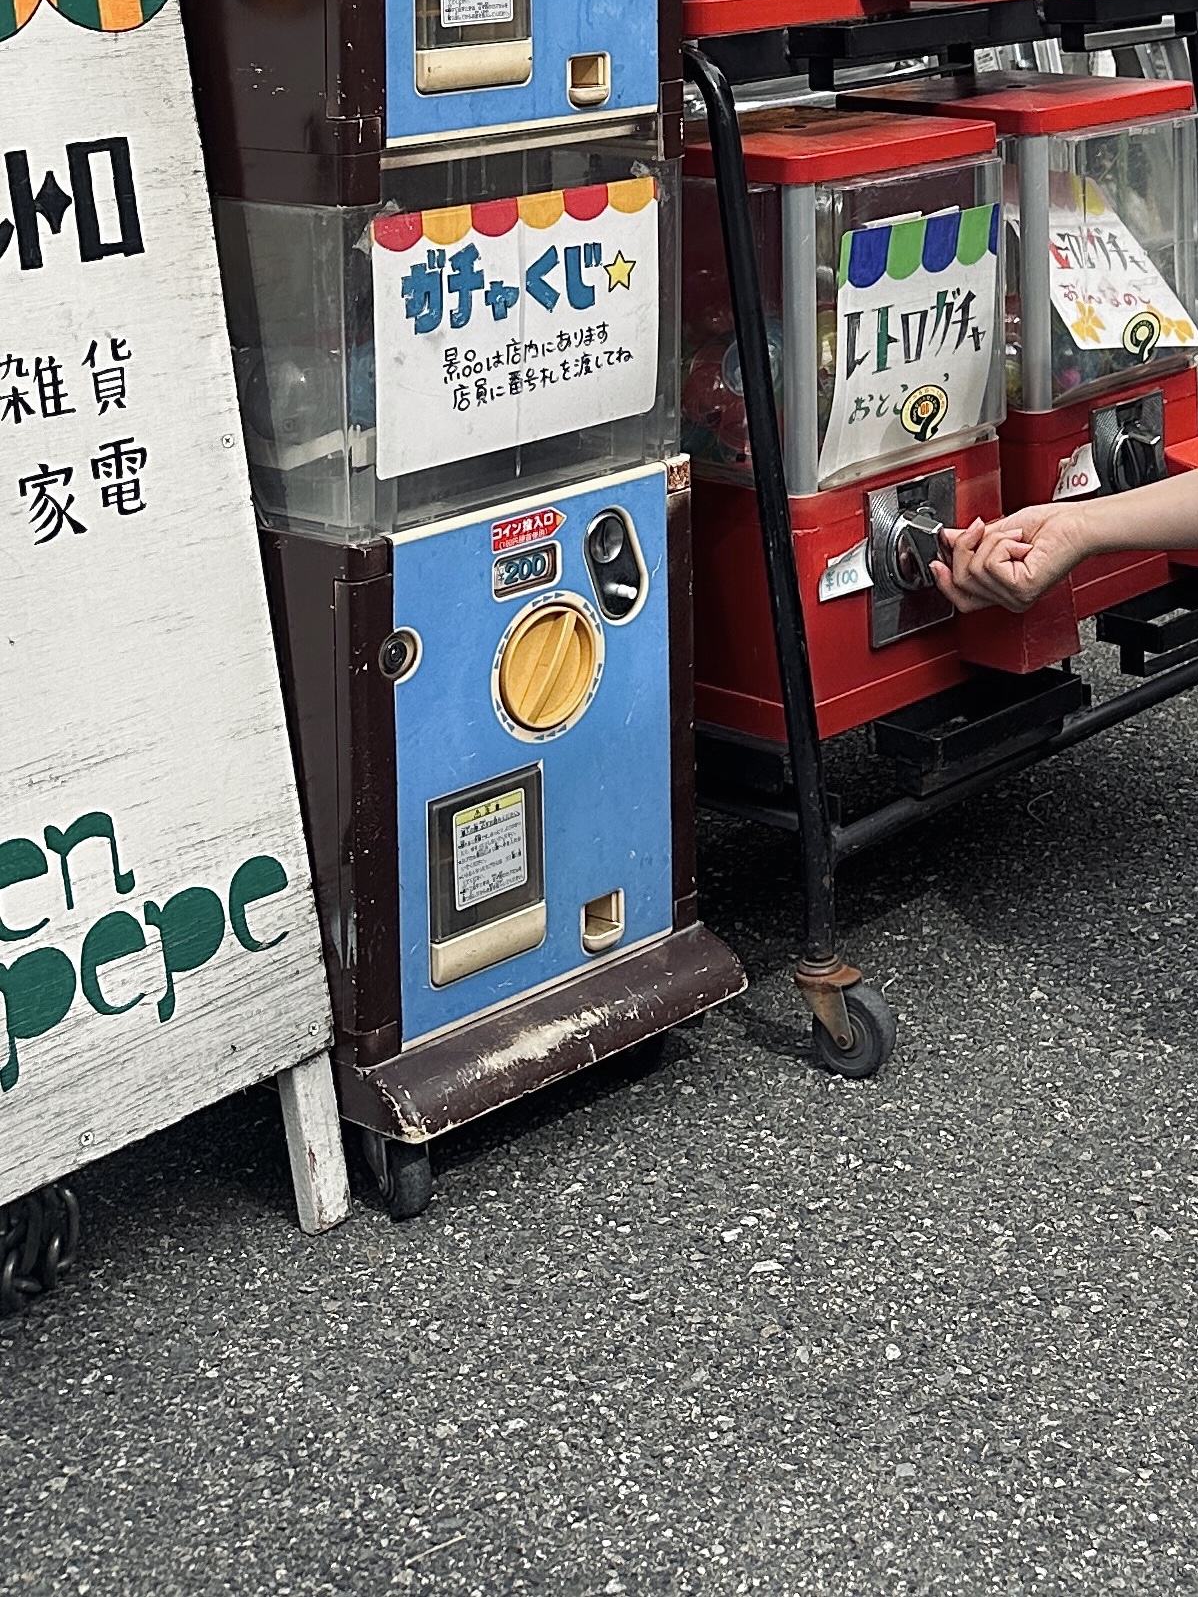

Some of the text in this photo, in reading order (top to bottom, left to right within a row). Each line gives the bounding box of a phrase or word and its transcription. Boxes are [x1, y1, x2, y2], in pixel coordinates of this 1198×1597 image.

[0, 136, 146, 271] トロ
[401, 242, 603, 335] ガチャくじ
[443, 320, 610, 385] 景品は店内にあります
[844, 288, 987, 381] レトロガチャ
[0, 336, 133, 424] 雑貨
[452, 346, 634, 412] 店員に番号札を渡してね
[18, 436, 148, 547] 家電
[492, 512, 554, 540] コイン投入口
[824, 568, 859, 592] ¥100
